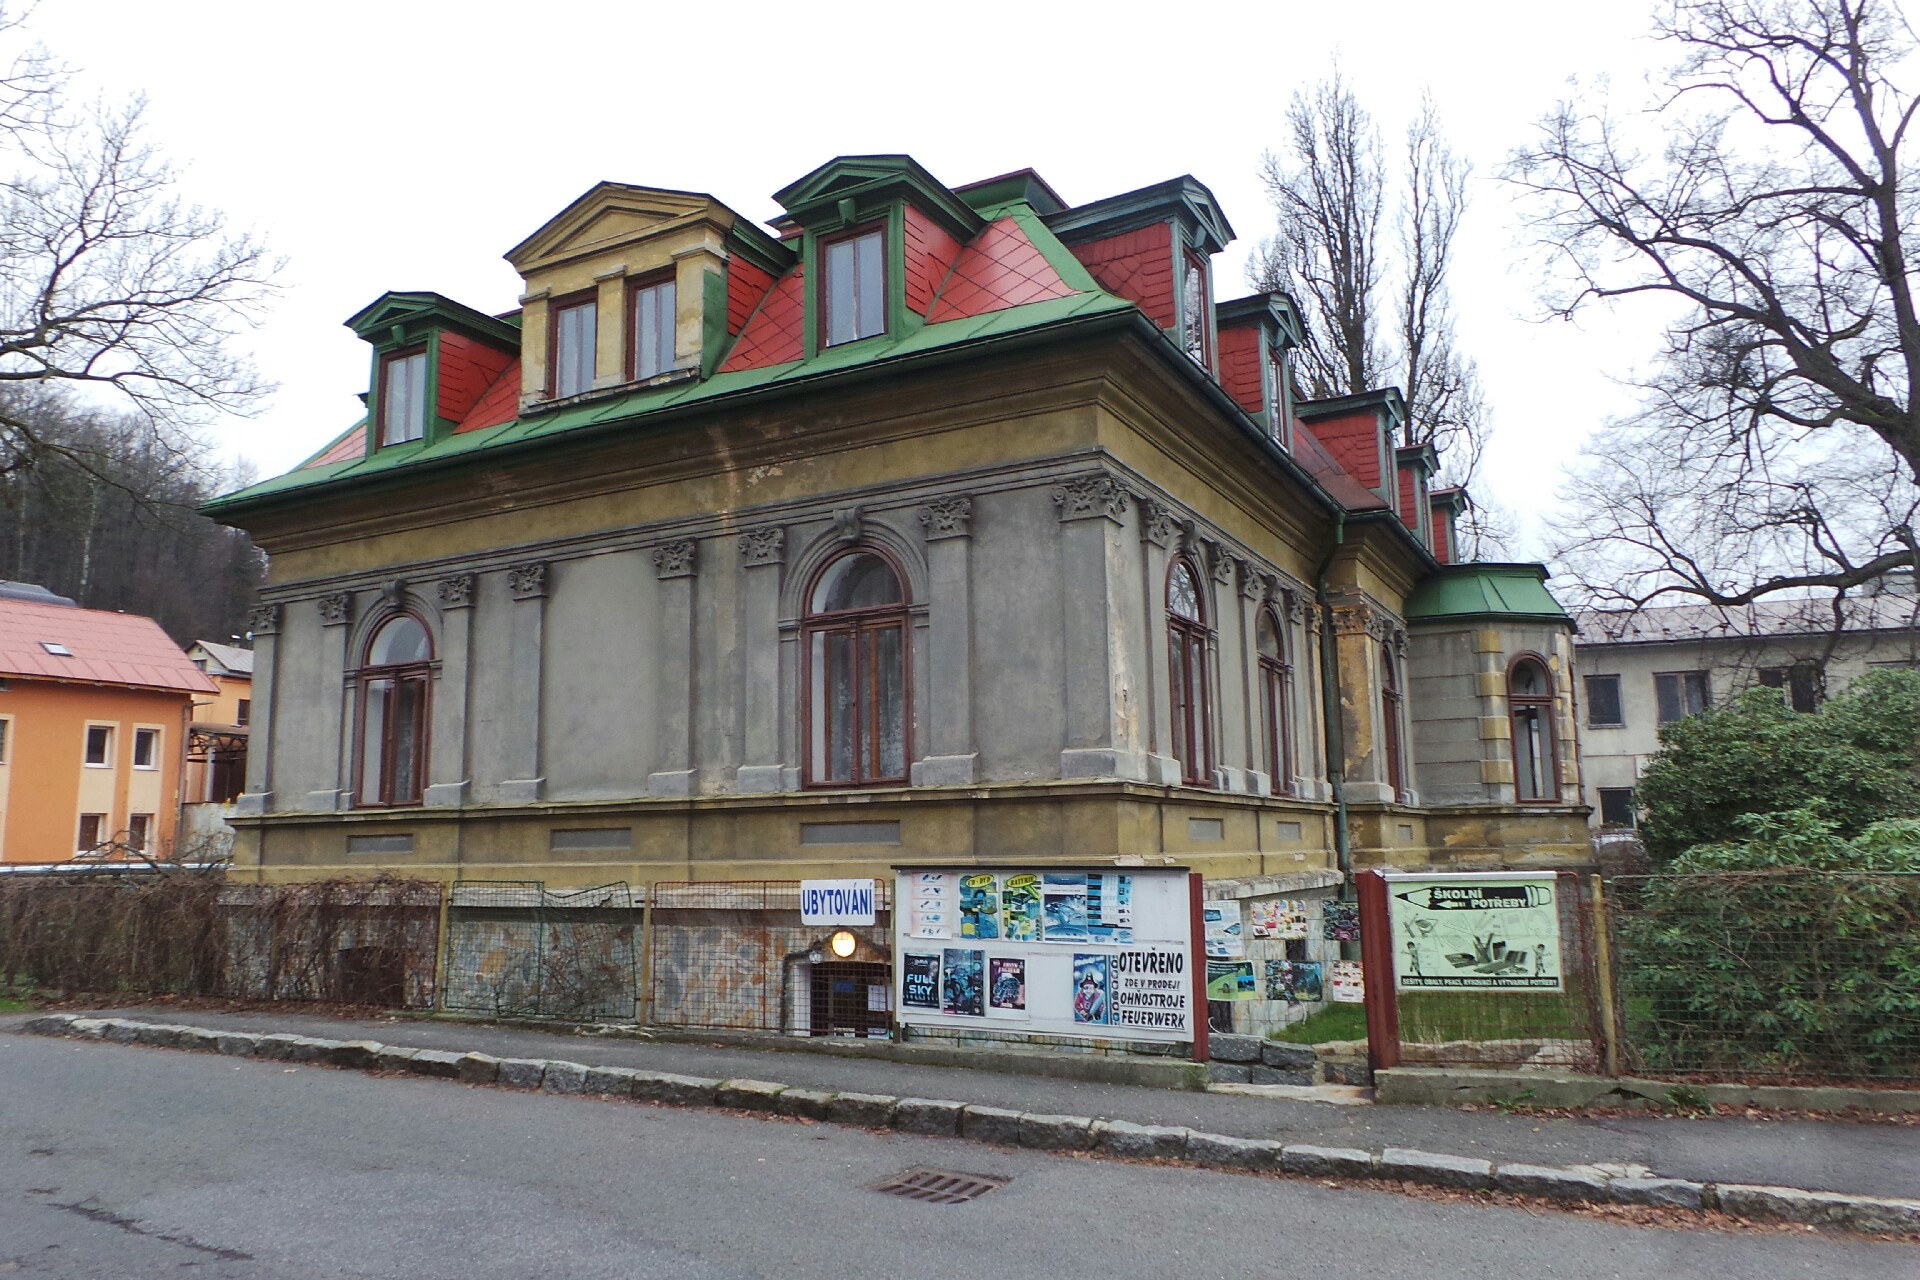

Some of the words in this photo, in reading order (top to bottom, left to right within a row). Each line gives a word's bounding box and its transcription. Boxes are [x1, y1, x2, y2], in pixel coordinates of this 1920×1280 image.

[803, 882, 872, 915] UBYTOVÁNÍ
[1433, 888, 1483, 899] ŠKOLNÍ
[1470, 896, 1526, 908] POTŘEBY
[1120, 946, 1183, 974] OTEVŘENO
[906, 973, 935, 984] FULL
[1124, 978, 1138, 987] ZDE
[1140, 979, 1146, 988] V
[908, 984, 933, 995] SKY
[1120, 990, 1185, 1008] OHŇOSTROJE
[1121, 1009, 1186, 1028] FEUERWERK
